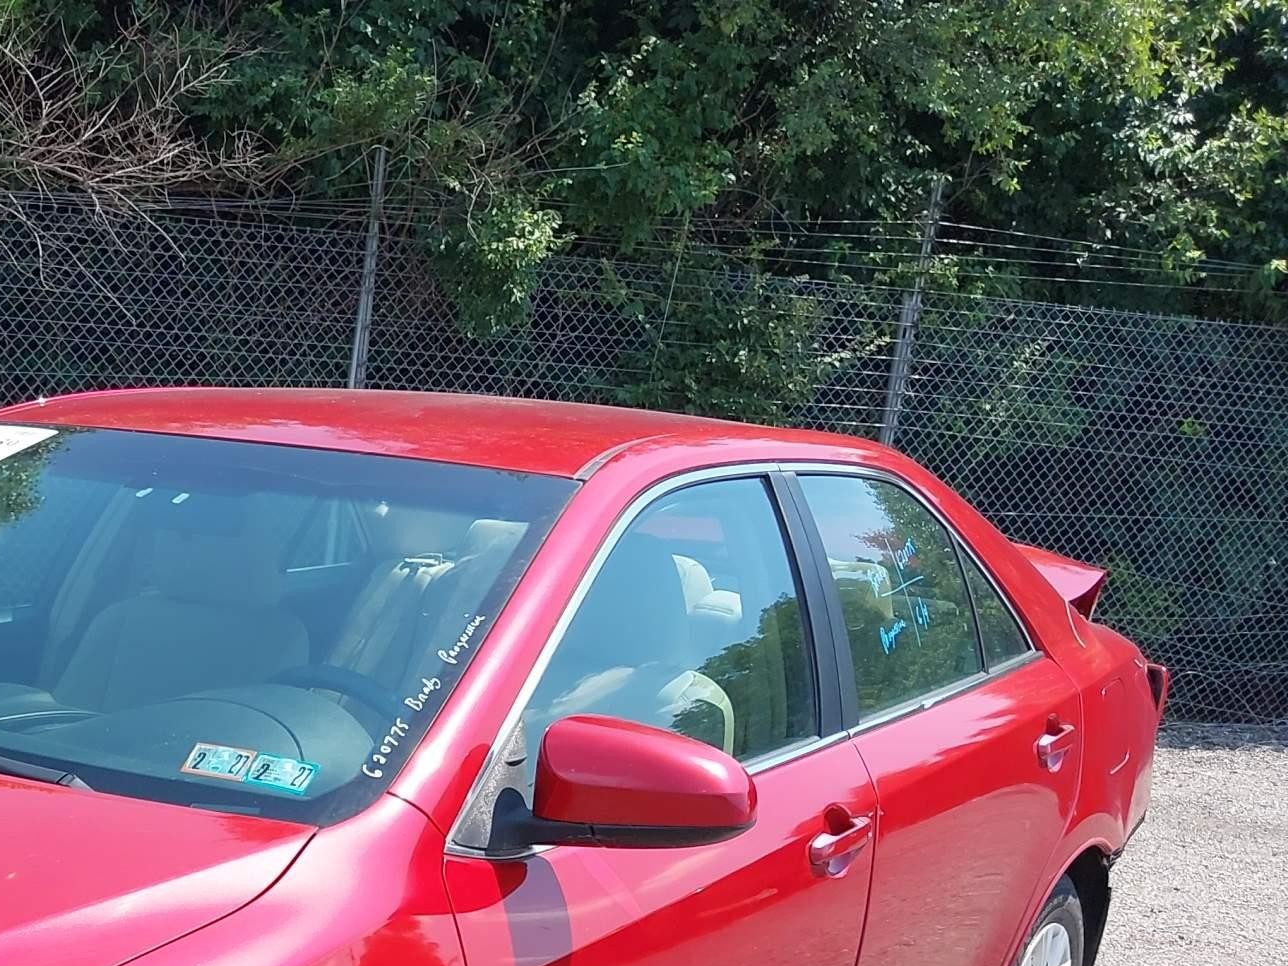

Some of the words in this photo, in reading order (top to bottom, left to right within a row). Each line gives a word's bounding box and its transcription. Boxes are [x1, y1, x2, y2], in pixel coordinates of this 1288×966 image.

[362, 717, 409, 779] 620775
[191, 752, 207, 770] 2
[228, 753, 250, 777] 27
[253, 763, 271, 782] 2
[289, 766, 314, 788] 27
